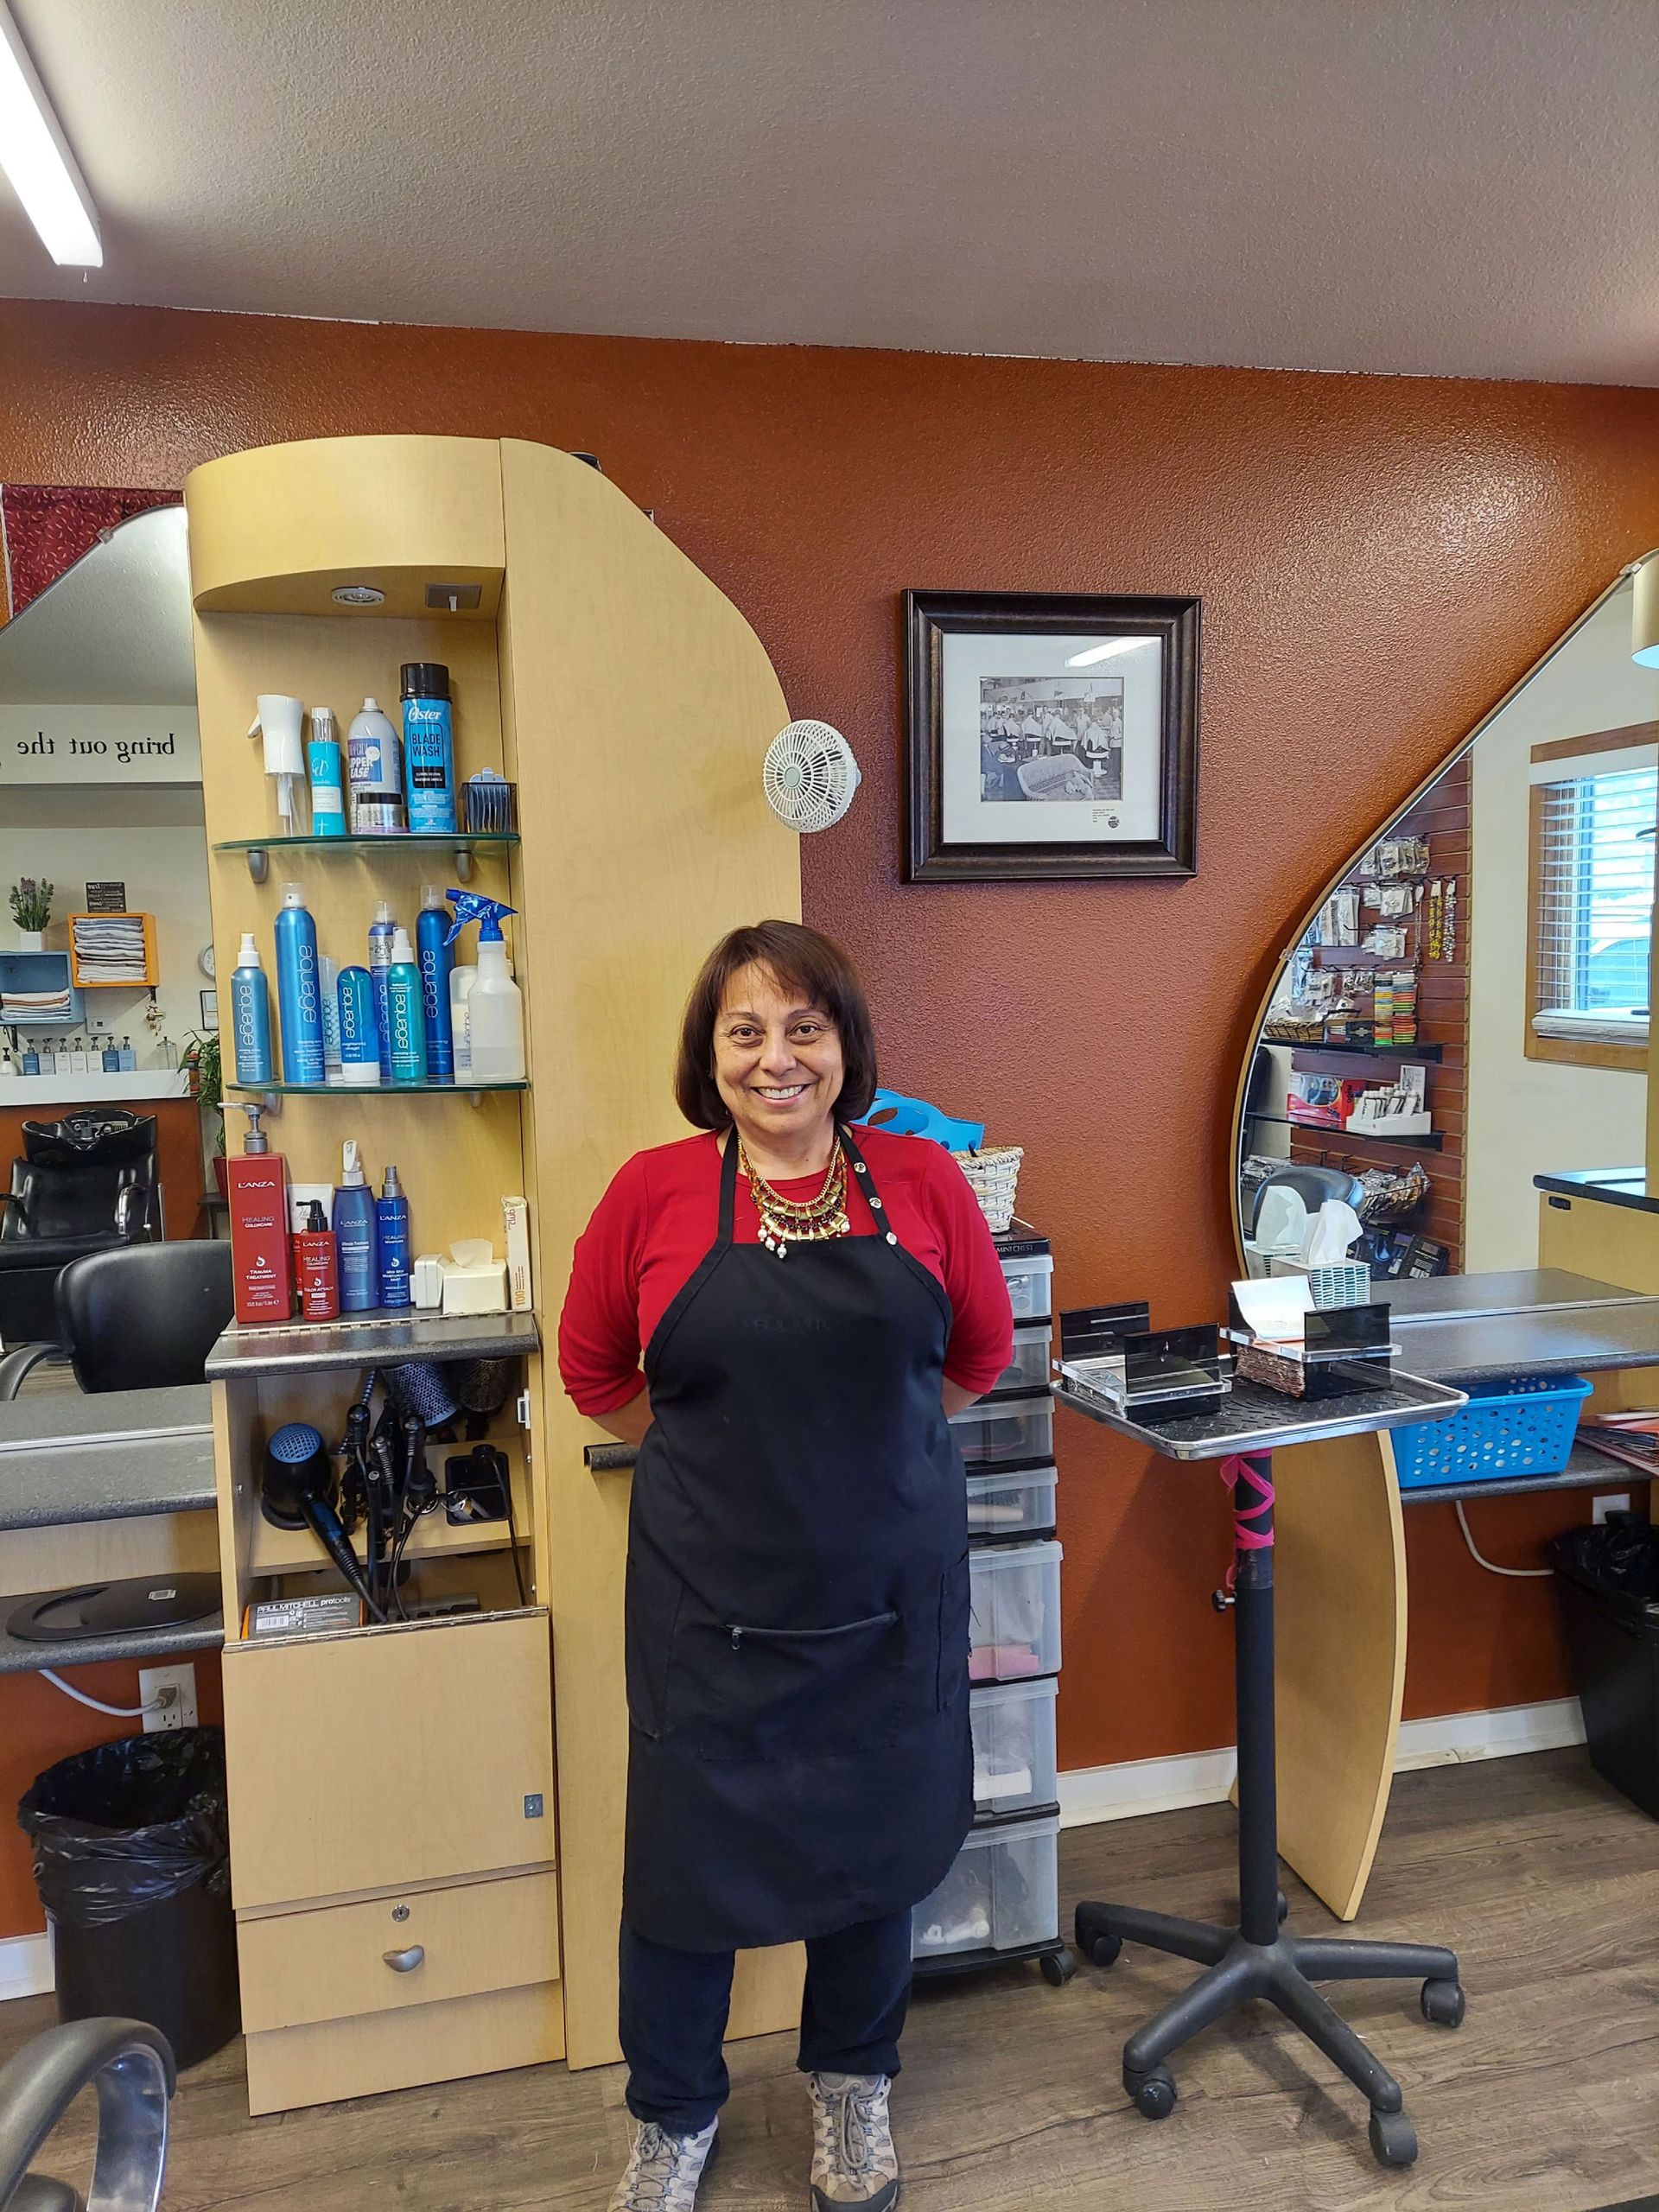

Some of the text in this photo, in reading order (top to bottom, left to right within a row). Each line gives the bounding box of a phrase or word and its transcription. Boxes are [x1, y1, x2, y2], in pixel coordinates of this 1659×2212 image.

[408, 705, 442, 722] Oster
[412, 734, 441, 745] BLADE
[412, 745, 440, 757] WASH
[297, 945, 317, 1024] aquage
[421, 950, 439, 1019] aquage
[239, 985, 255, 1046] aquage
[322, 998, 334, 1046] aquage
[342, 987, 355, 1039] aquage
[394, 994, 409, 1049] aquage
[279, 1599, 319, 1611] MITCHELL
[321, 1596, 351, 1607] protools
